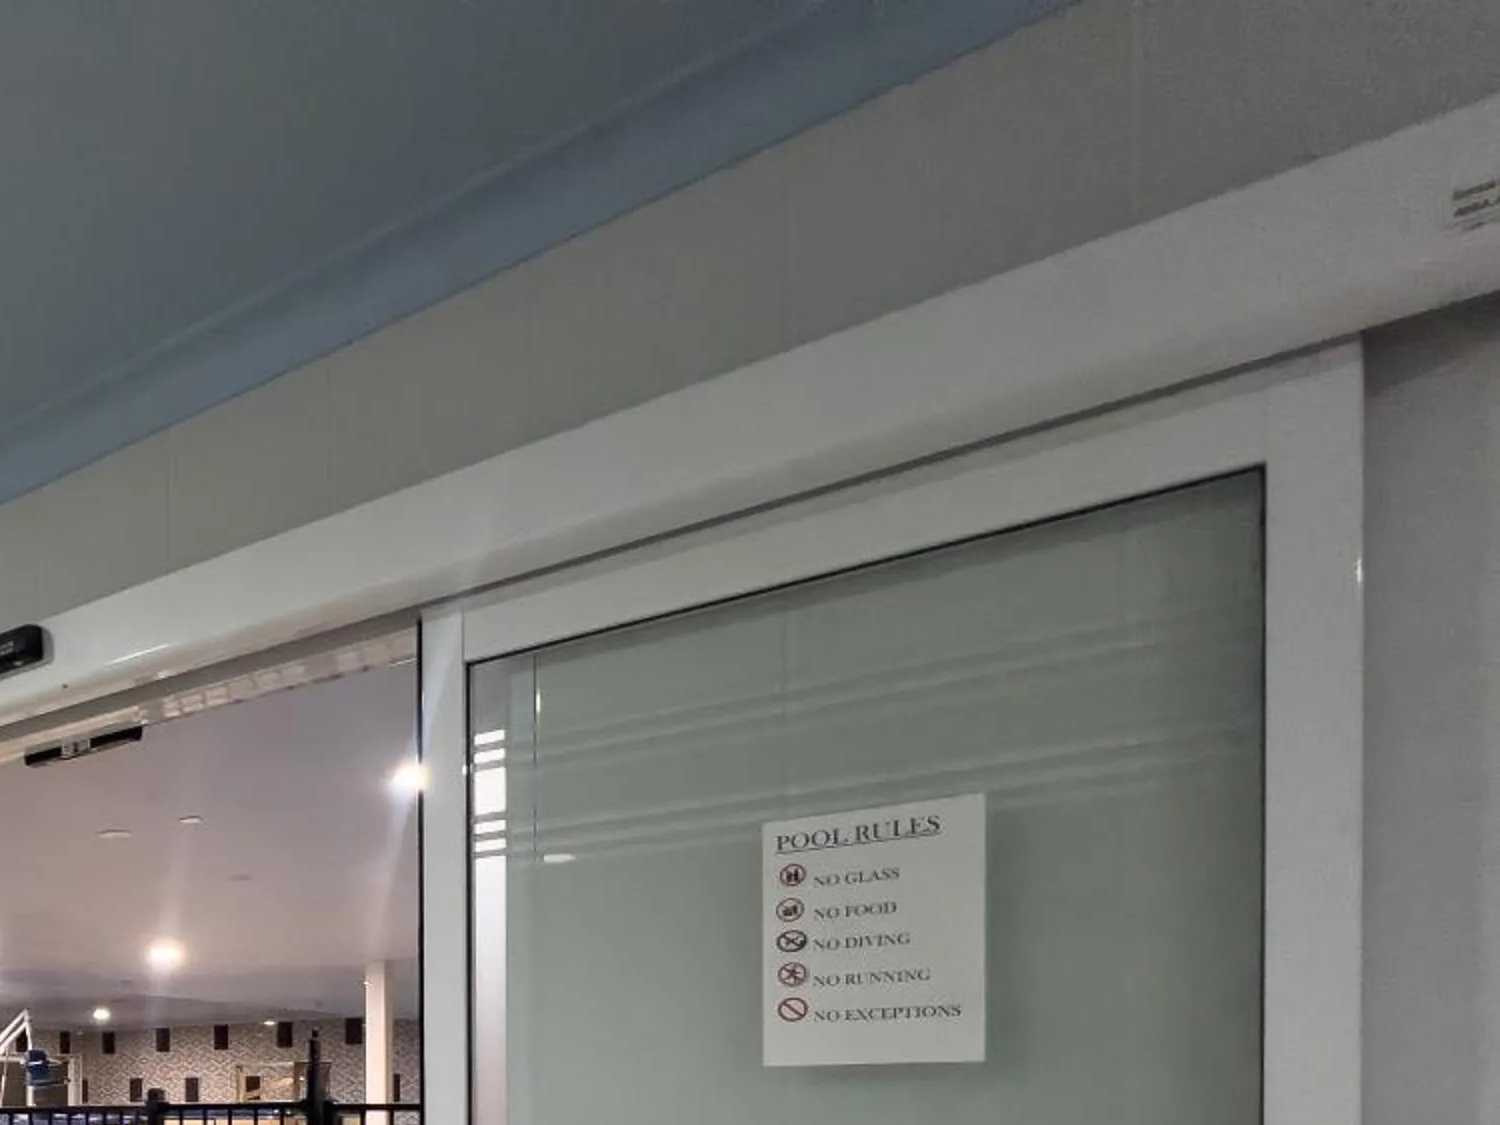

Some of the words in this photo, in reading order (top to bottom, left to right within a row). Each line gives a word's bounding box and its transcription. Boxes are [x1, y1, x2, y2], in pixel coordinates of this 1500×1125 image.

[775, 827, 849, 851] POOL
[855, 815, 941, 842] RULES
[813, 873, 840, 887] NO
[845, 867, 900, 885] GLASS
[813, 906, 840, 919] NO
[845, 901, 897, 918] FOOD
[813, 938, 840, 950] NO
[845, 932, 911, 949] DIVING
[813, 973, 840, 986] NO
[845, 968, 931, 985] RUNNING
[813, 1008, 840, 1022] NO
[845, 1004, 962, 1021] EXCEPTIONS
